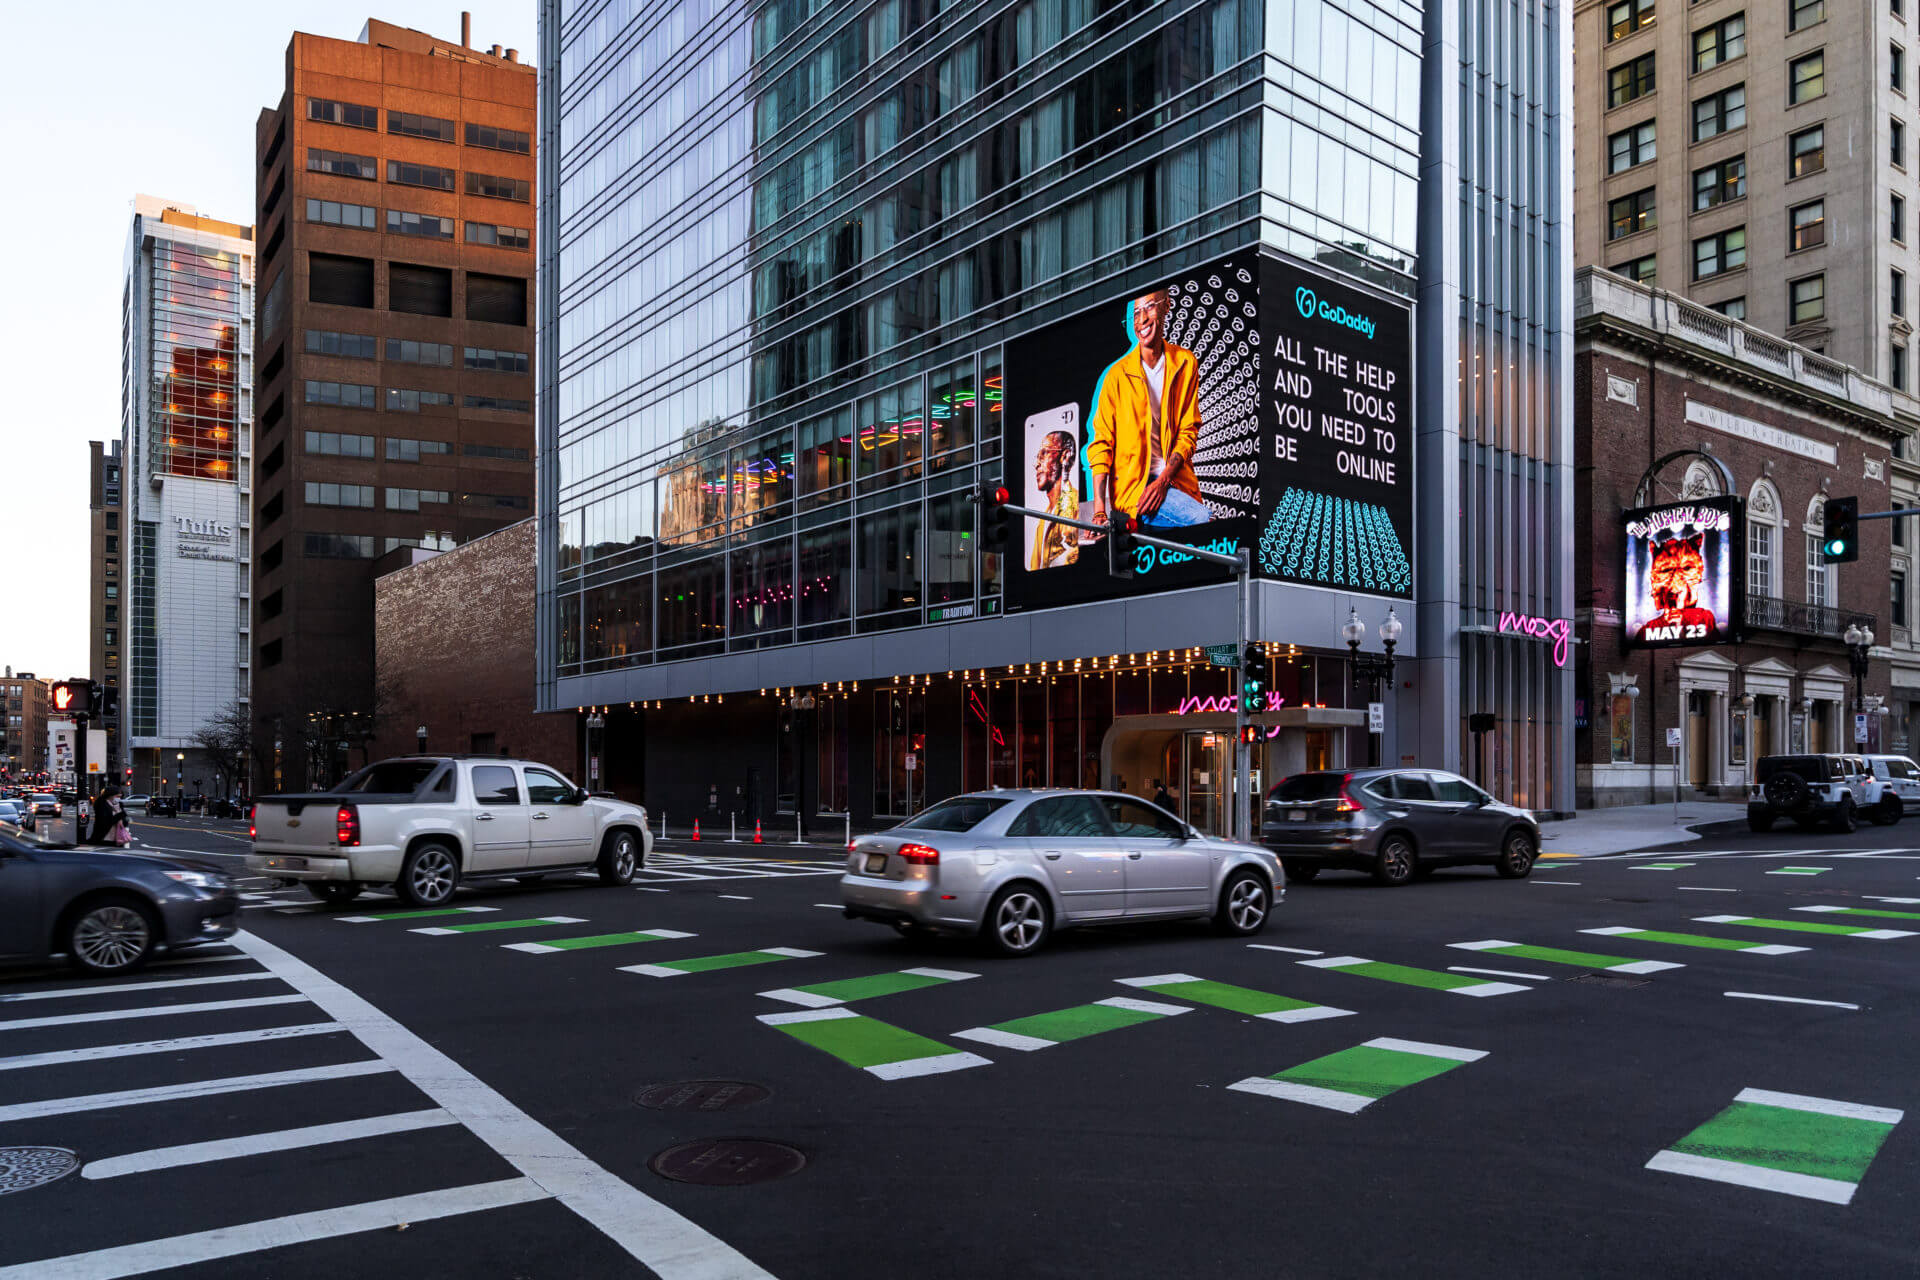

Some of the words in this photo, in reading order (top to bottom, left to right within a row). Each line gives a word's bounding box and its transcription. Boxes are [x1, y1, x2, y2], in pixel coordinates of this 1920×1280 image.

[1319, 300, 1375, 339] GoDaddy
[1274, 335, 1306, 366] ALL
[1313, 346, 1348, 378] THE
[1356, 360, 1396, 392] HELP
[1274, 368, 1312, 409] AND
[1343, 387, 1396, 423] TOOLS
[1274, 400, 1312, 432] YOU
[1321, 413, 1366, 446] NEED
[1373, 428, 1396, 453] TO
[1708, 410, 1760, 439] WILBUR
[1769, 430, 1817, 456] THEATRE
[1275, 434, 1298, 462] BE
[1336, 450, 1396, 485] ONLINE
[171, 515, 232, 537] Tufts
[1645, 506, 1696, 538] MUSICAL
[1697, 506, 1729, 531] BOX
[1645, 625, 1683, 641] MAY
[1686, 623, 1707, 639] 23
